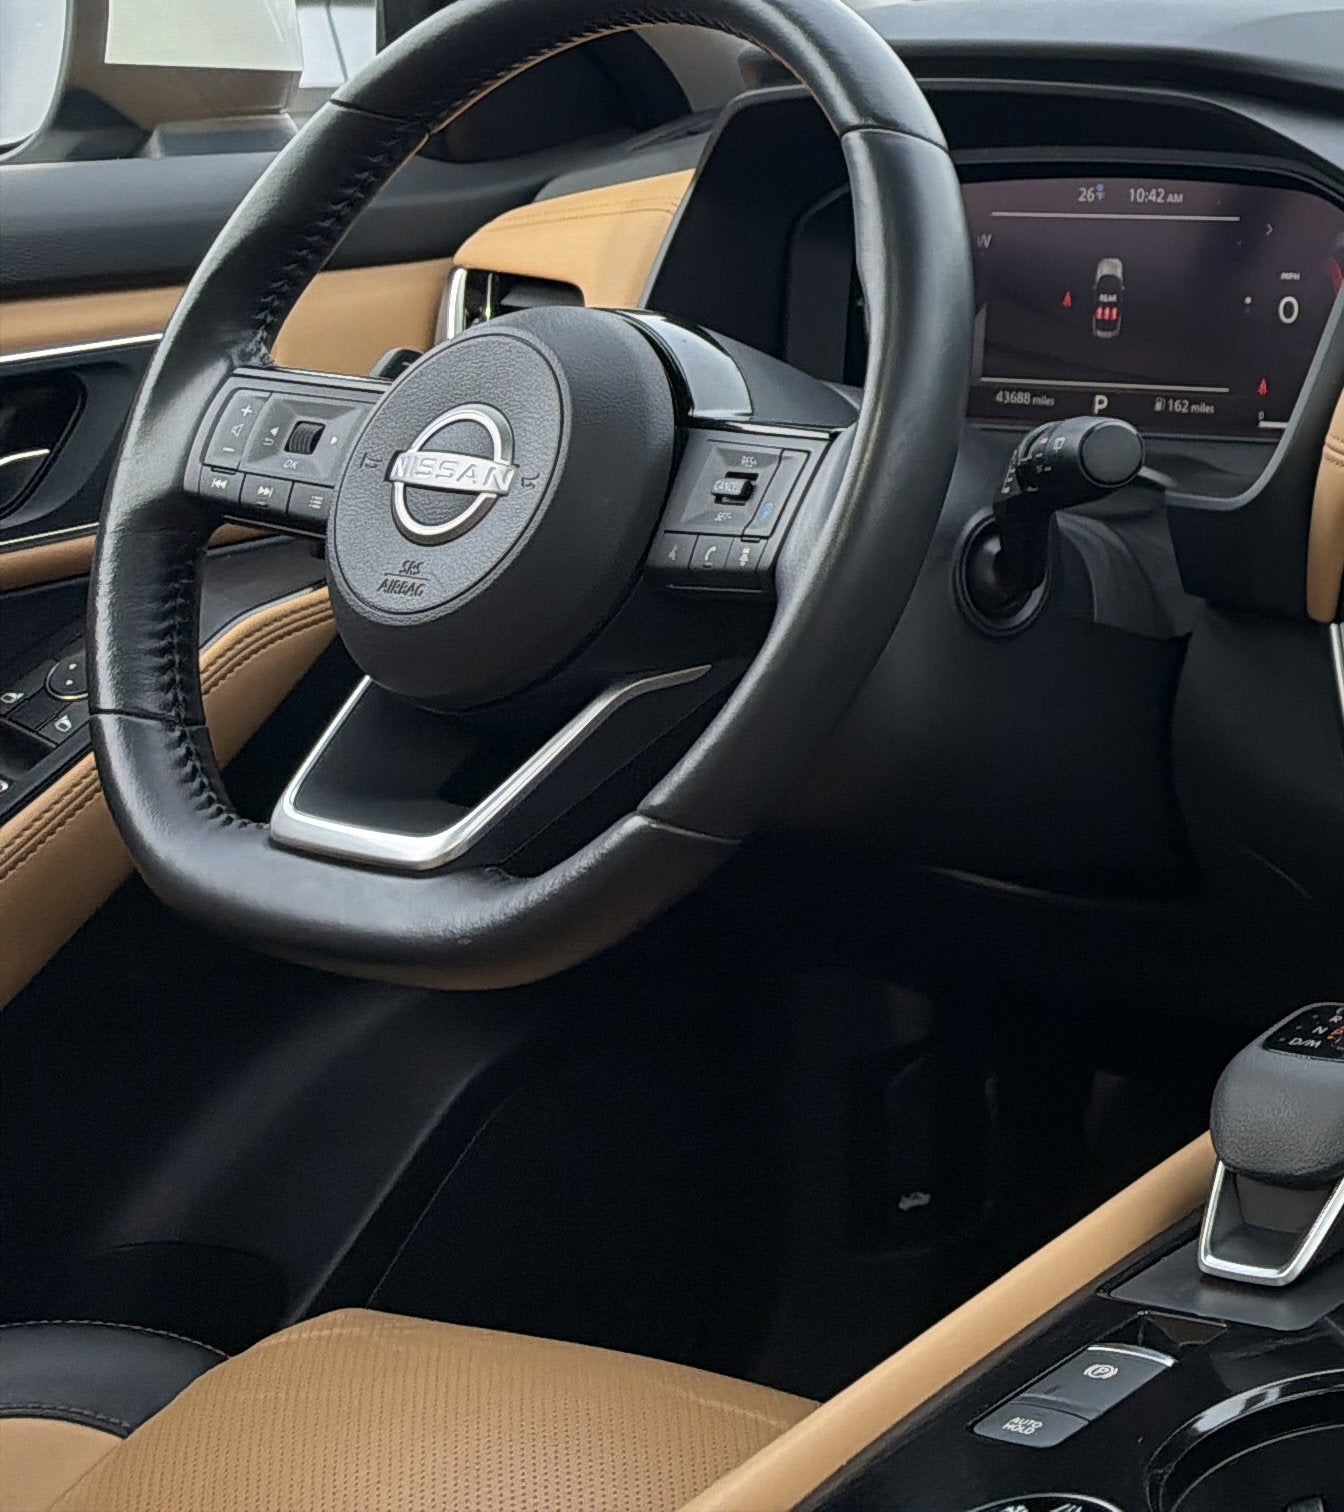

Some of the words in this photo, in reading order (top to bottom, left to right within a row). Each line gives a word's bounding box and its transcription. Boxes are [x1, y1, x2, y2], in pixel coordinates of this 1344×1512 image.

[1129, 187, 1165, 203] 10:42
[1167, 192, 1184, 203] AM
[1278, 296, 1299, 324] 0
[1032, 395, 1055, 406] miles
[1093, 394, 1109, 415] P
[1167, 398, 1190, 413] 162
[1191, 402, 1215, 414] miles
[283, 459, 299, 469] OK
[392, 454, 514, 492] NISSAN
[376, 577, 427, 597] AIRBAG
[1312, 1025, 1329, 1034] N
[1002, 1422, 1036, 1435] HOLD
[1008, 1416, 1043, 1429] AUTO
